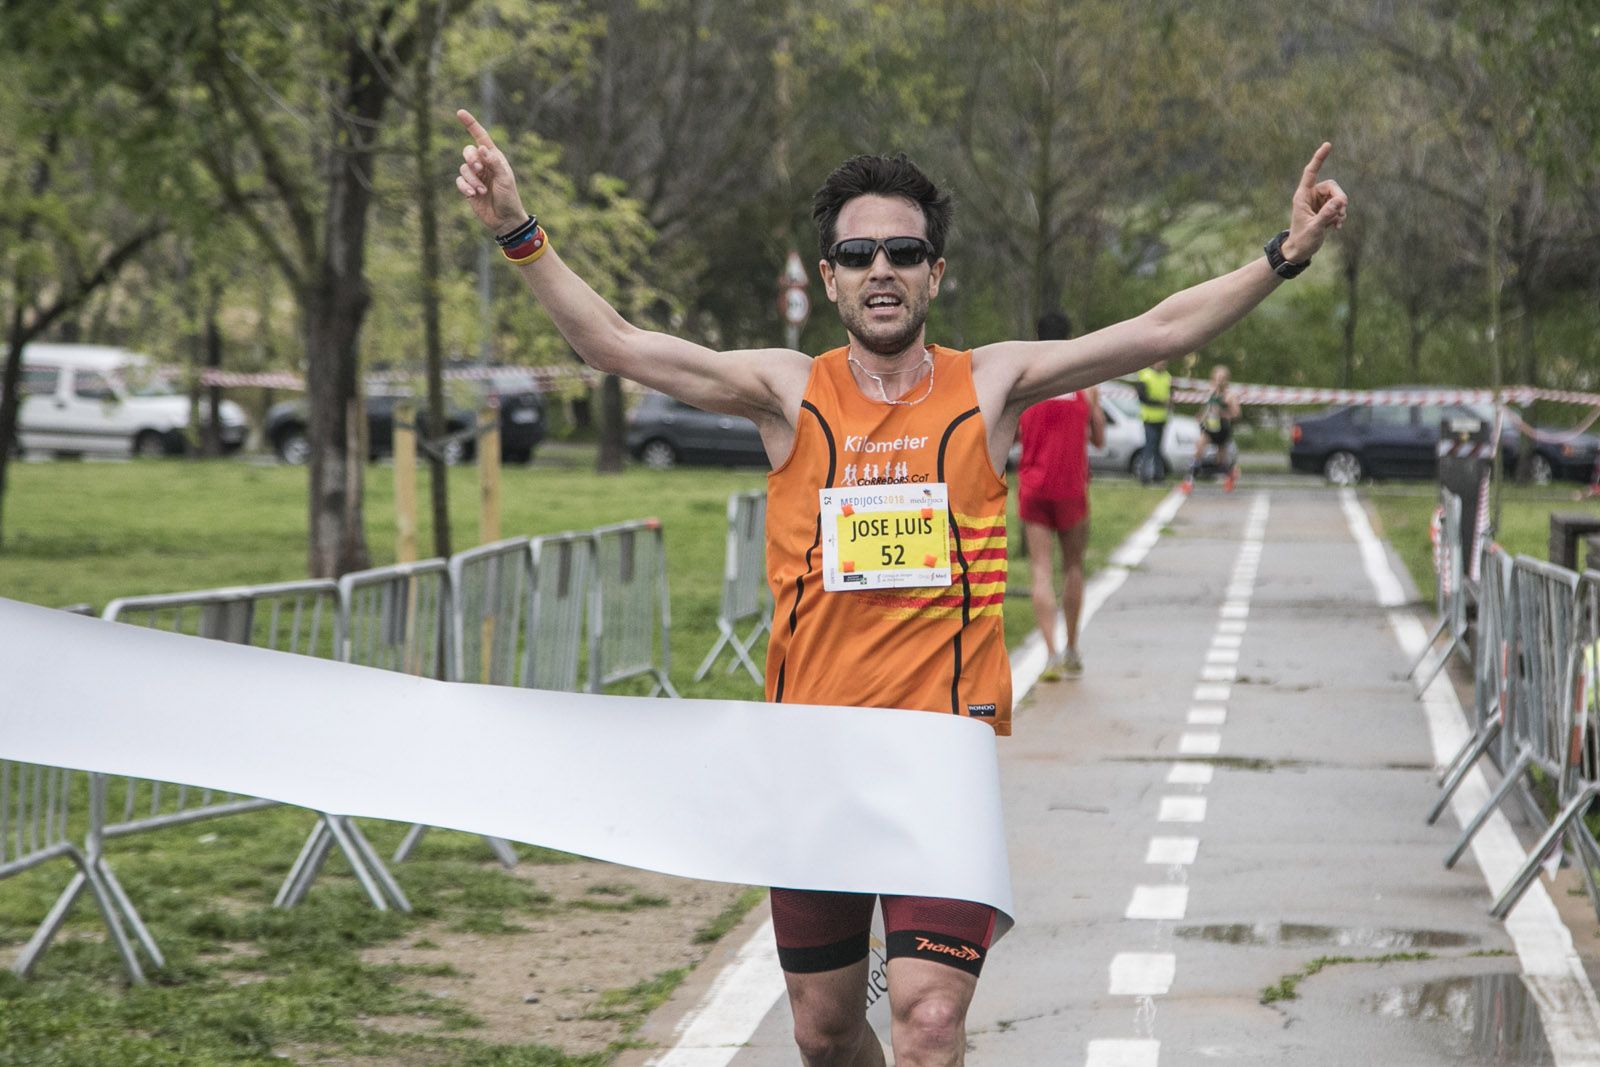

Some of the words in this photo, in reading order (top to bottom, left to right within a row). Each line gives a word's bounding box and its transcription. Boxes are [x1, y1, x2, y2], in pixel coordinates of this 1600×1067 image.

[844, 435, 929, 453] Kilometer
[850, 519, 889, 542] JOSE
[895, 517, 933, 538] LUIS
[881, 545, 906, 566] 52
